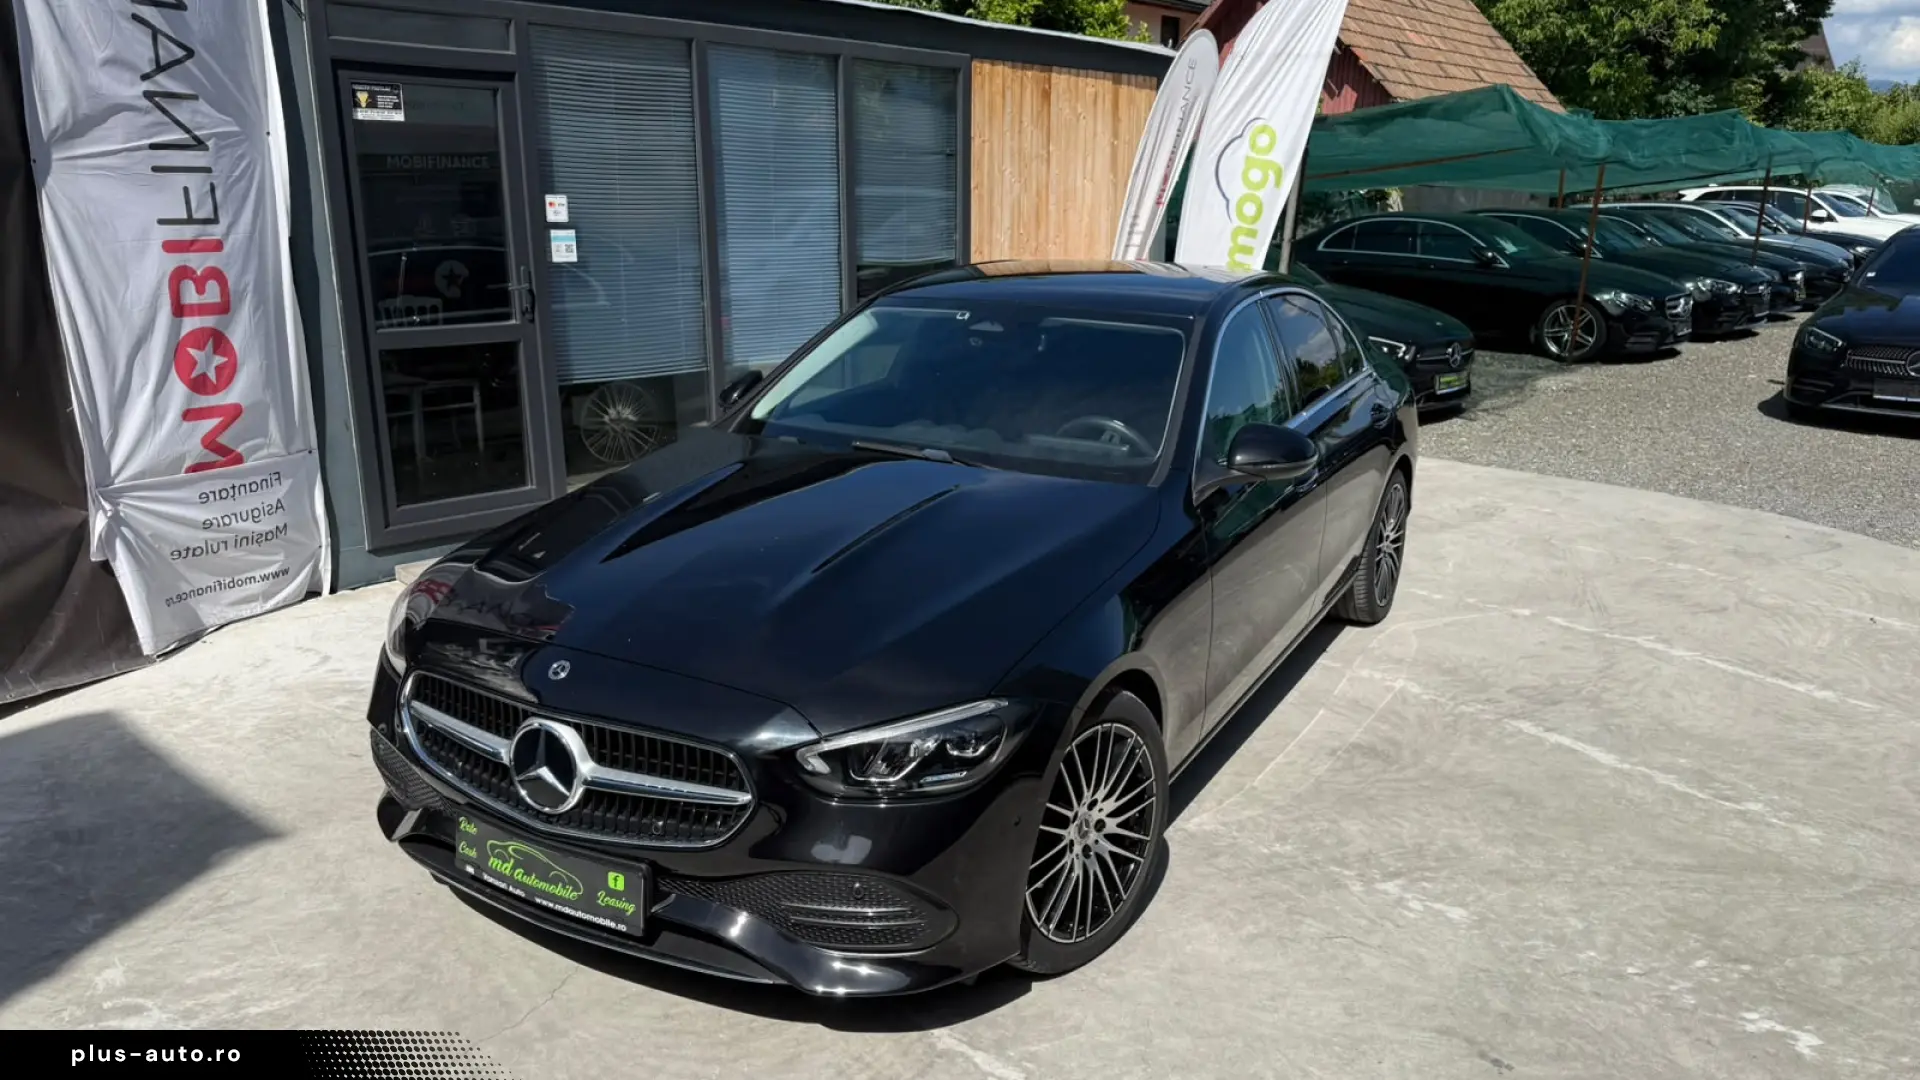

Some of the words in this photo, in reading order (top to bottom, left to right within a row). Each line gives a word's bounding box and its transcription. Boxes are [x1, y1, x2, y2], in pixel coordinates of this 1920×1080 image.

[386, 155, 490, 169] MOBIFINANCE
[1224, 124, 1284, 272] mogo
[488, 856, 512, 877] md
[534, 896, 628, 932] www.mdautomobile.ro
[596, 890, 636, 916] Leasing
